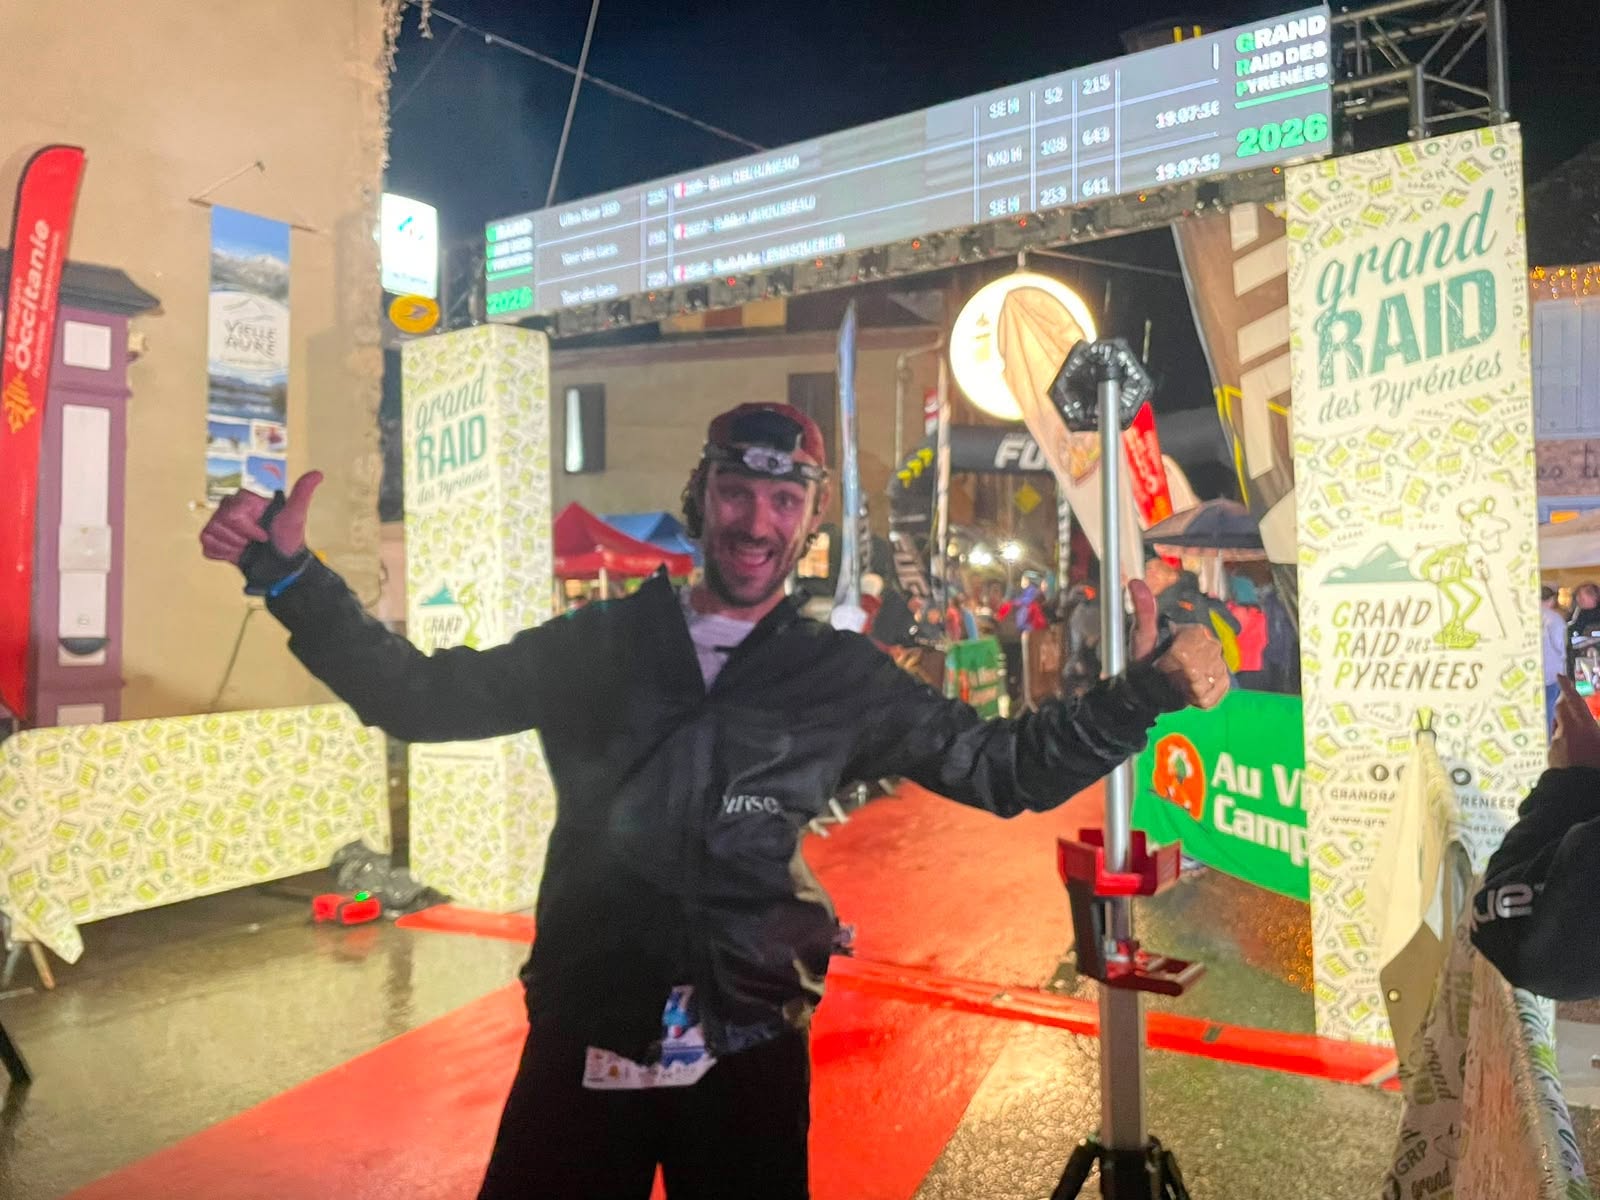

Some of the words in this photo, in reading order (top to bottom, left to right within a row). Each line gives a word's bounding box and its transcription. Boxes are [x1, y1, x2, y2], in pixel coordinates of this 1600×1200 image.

[1235, 14, 1327, 53] GRAND
[1235, 51, 1284, 77] RAID
[1286, 41, 1328, 64] DES
[1236, 113, 1328, 158] 2026
[1315, 187, 1498, 318] grand
[15, 219, 50, 371] Occitanie
[224, 336, 276, 359] AURE
[1317, 269, 1497, 389] RAID
[416, 363, 488, 433] grand
[1318, 389, 1360, 424] des
[1370, 351, 1503, 418] Pyrénées
[417, 414, 487, 484] RAID
[1331, 595, 1432, 628] GRAND
[1333, 630, 1400, 657] RAID
[1405, 636, 1431, 652] DES
[1211, 752, 1263, 799] Au
